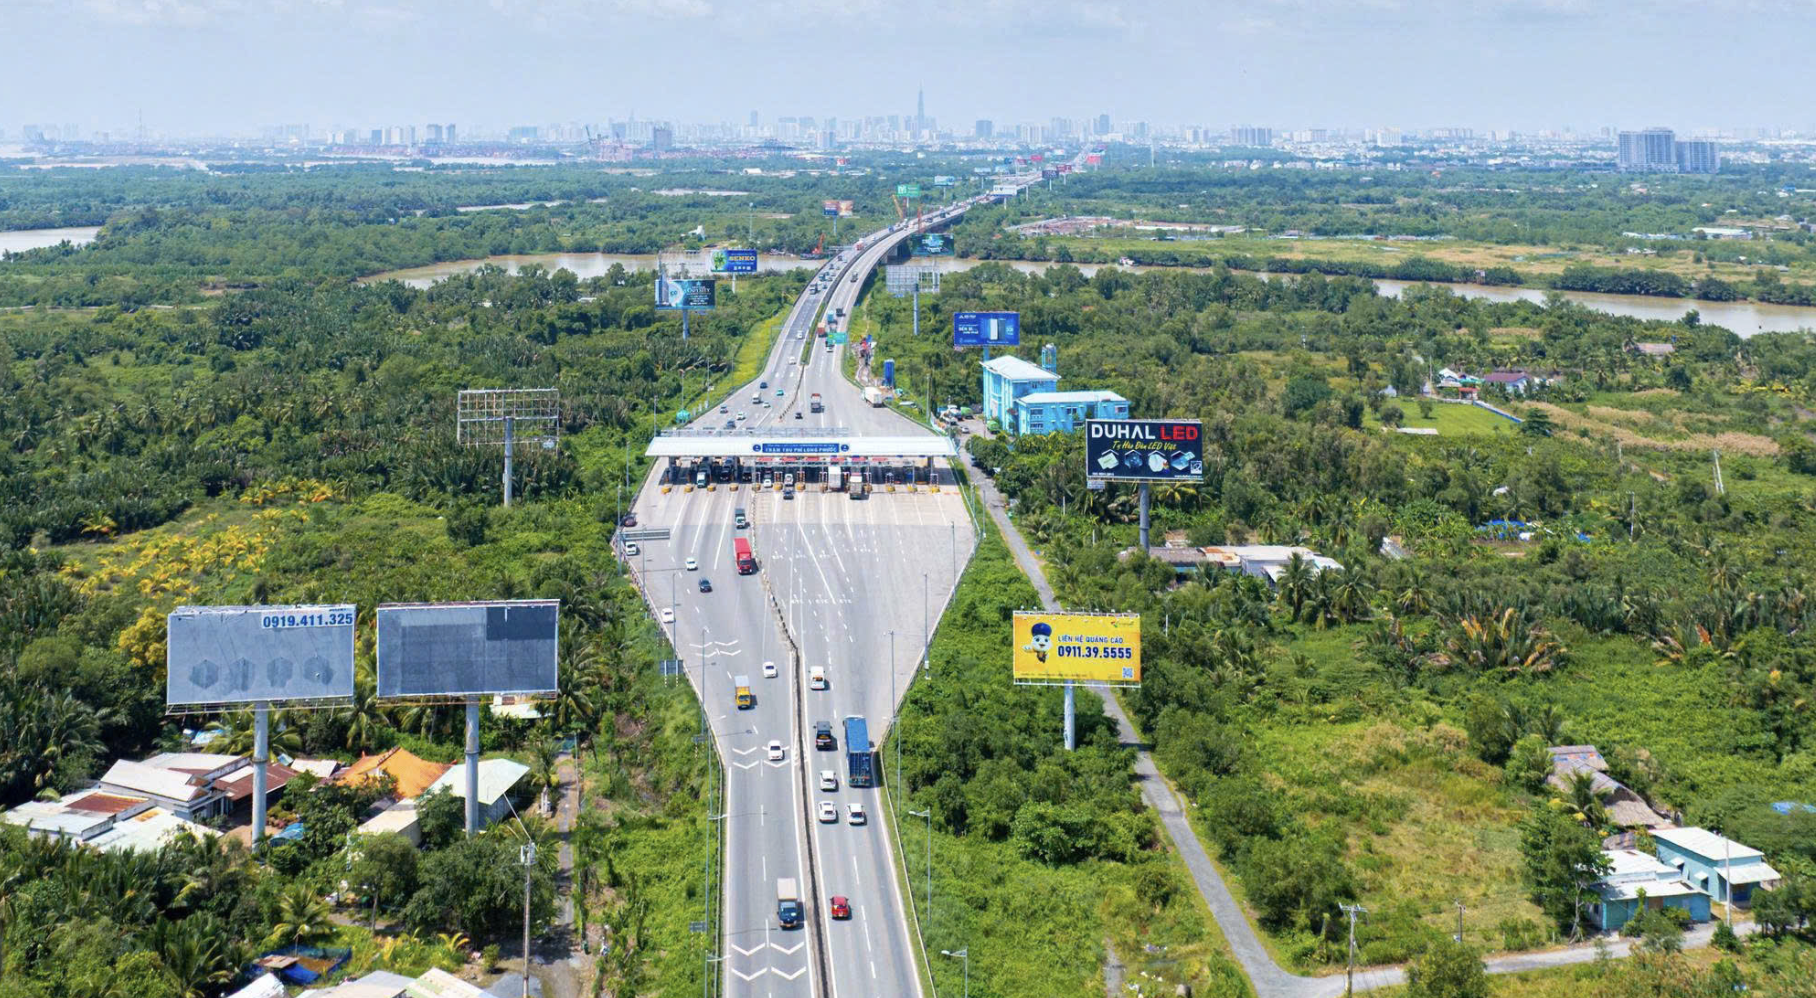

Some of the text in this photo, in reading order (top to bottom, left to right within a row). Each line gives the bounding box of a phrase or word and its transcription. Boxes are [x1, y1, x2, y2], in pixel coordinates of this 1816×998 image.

[1091, 424, 1198, 440] DUHAL LED
[1148, 442, 1163, 450] LED
[263, 613, 353, 628] 0919.411.325
[1058, 634, 1073, 643] LIÊN
[1075, 634, 1083, 644] HỆ
[1058, 645, 1132, 659] 0911.39.5555
